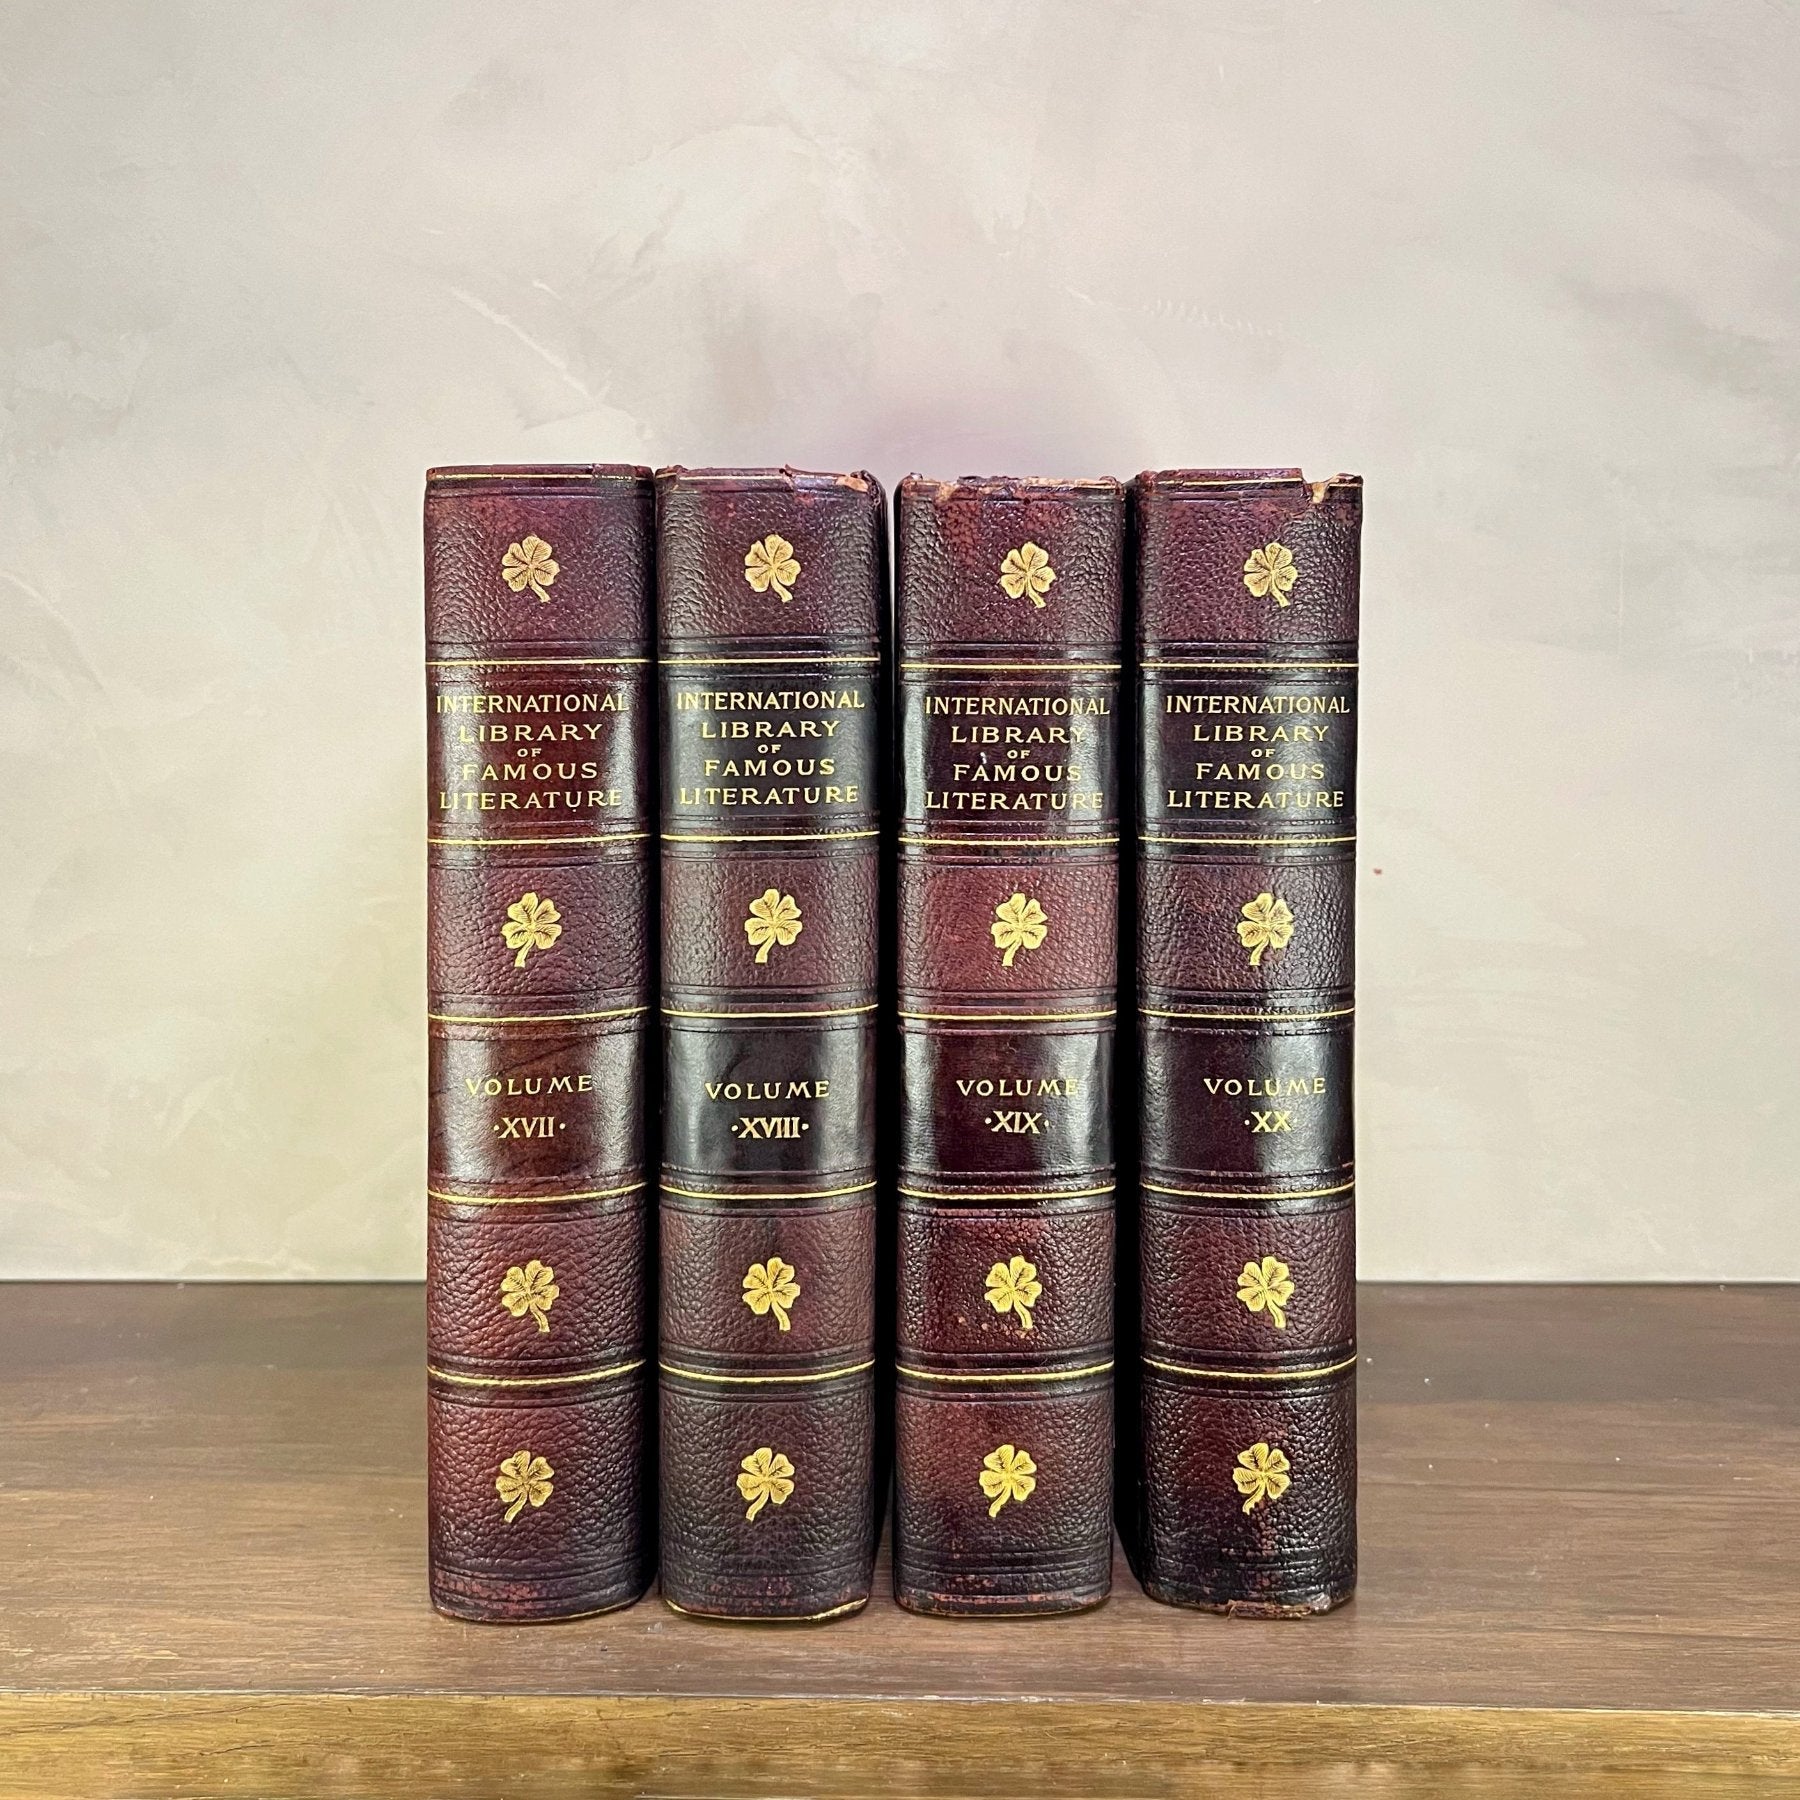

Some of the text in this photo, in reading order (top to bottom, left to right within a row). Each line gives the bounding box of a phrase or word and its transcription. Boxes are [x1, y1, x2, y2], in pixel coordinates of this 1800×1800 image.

[437, 694, 629, 713] INTERNATIONAL
[677, 690, 864, 710] INTERNATIONAL
[926, 697, 1109, 716] INTERNATIONAL
[1166, 696, 1349, 714] INTERNATIONAL
[460, 724, 602, 742] LIBRARY
[702, 721, 840, 738] LIBRARY
[952, 726, 1087, 743] LIBRARY
[1194, 725, 1329, 742] LIBRARY
[517, 748, 541, 757] OF
[758, 744, 781, 753] OF
[1007, 750, 1030, 759] OF
[1251, 749, 1275, 758] OF
[463, 762, 597, 780] FAMOUS
[705, 759, 835, 776] FAMOUS
[954, 764, 1081, 781] FAMOUS
[1196, 763, 1324, 780] FAMOUS
[440, 790, 622, 810] LITERATURE
[680, 786, 858, 805] LITERATURE
[927, 792, 1103, 810] LITERATURE
[1167, 790, 1344, 808] LITERATURE
[465, 1075, 592, 1096] VOLUME
[705, 1080, 830, 1100] VOLUME
[956, 1079, 1078, 1096] VOLUME
[1203, 1078, 1326, 1095] VOLUME
